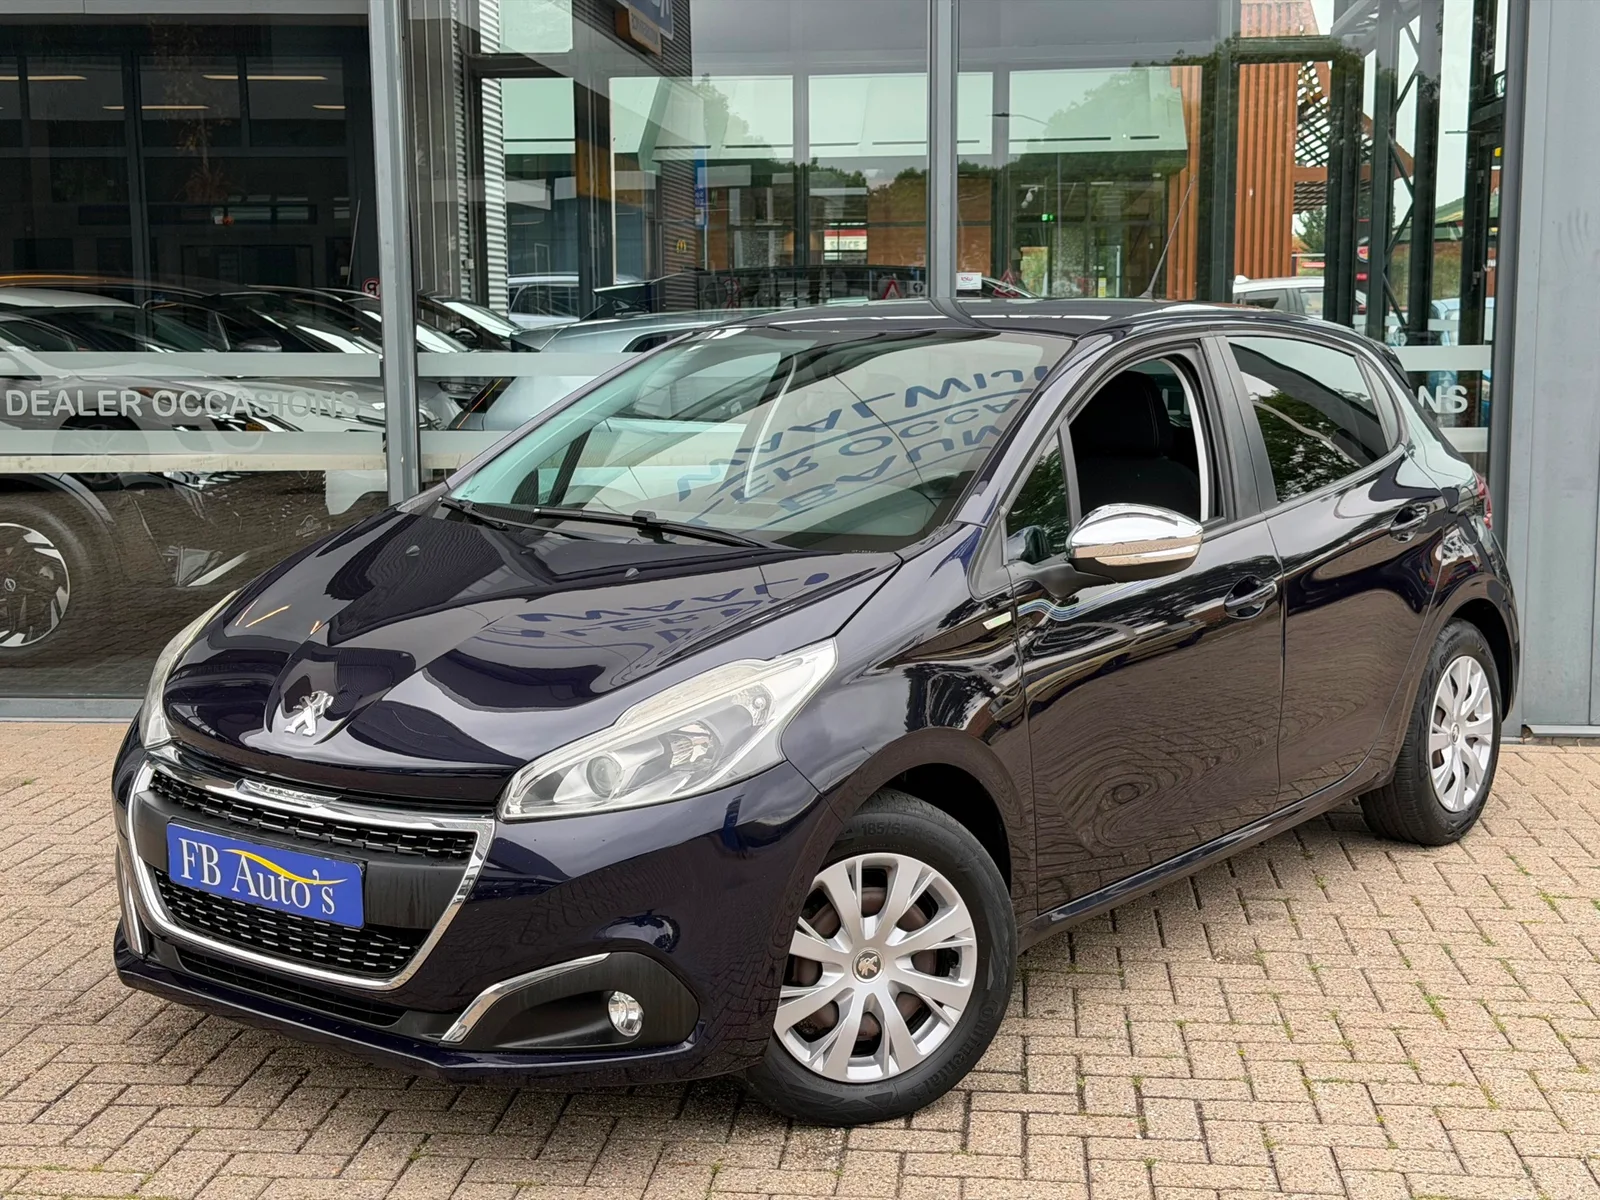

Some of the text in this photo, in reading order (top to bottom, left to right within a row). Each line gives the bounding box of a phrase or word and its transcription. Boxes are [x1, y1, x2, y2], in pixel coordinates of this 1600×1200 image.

[829, 240, 861, 249] SNCE
[5, 389, 361, 418] DEALER OCCASIONS
[1418, 385, 1468, 414] NS
[178, 837, 336, 915] FB Auto's
